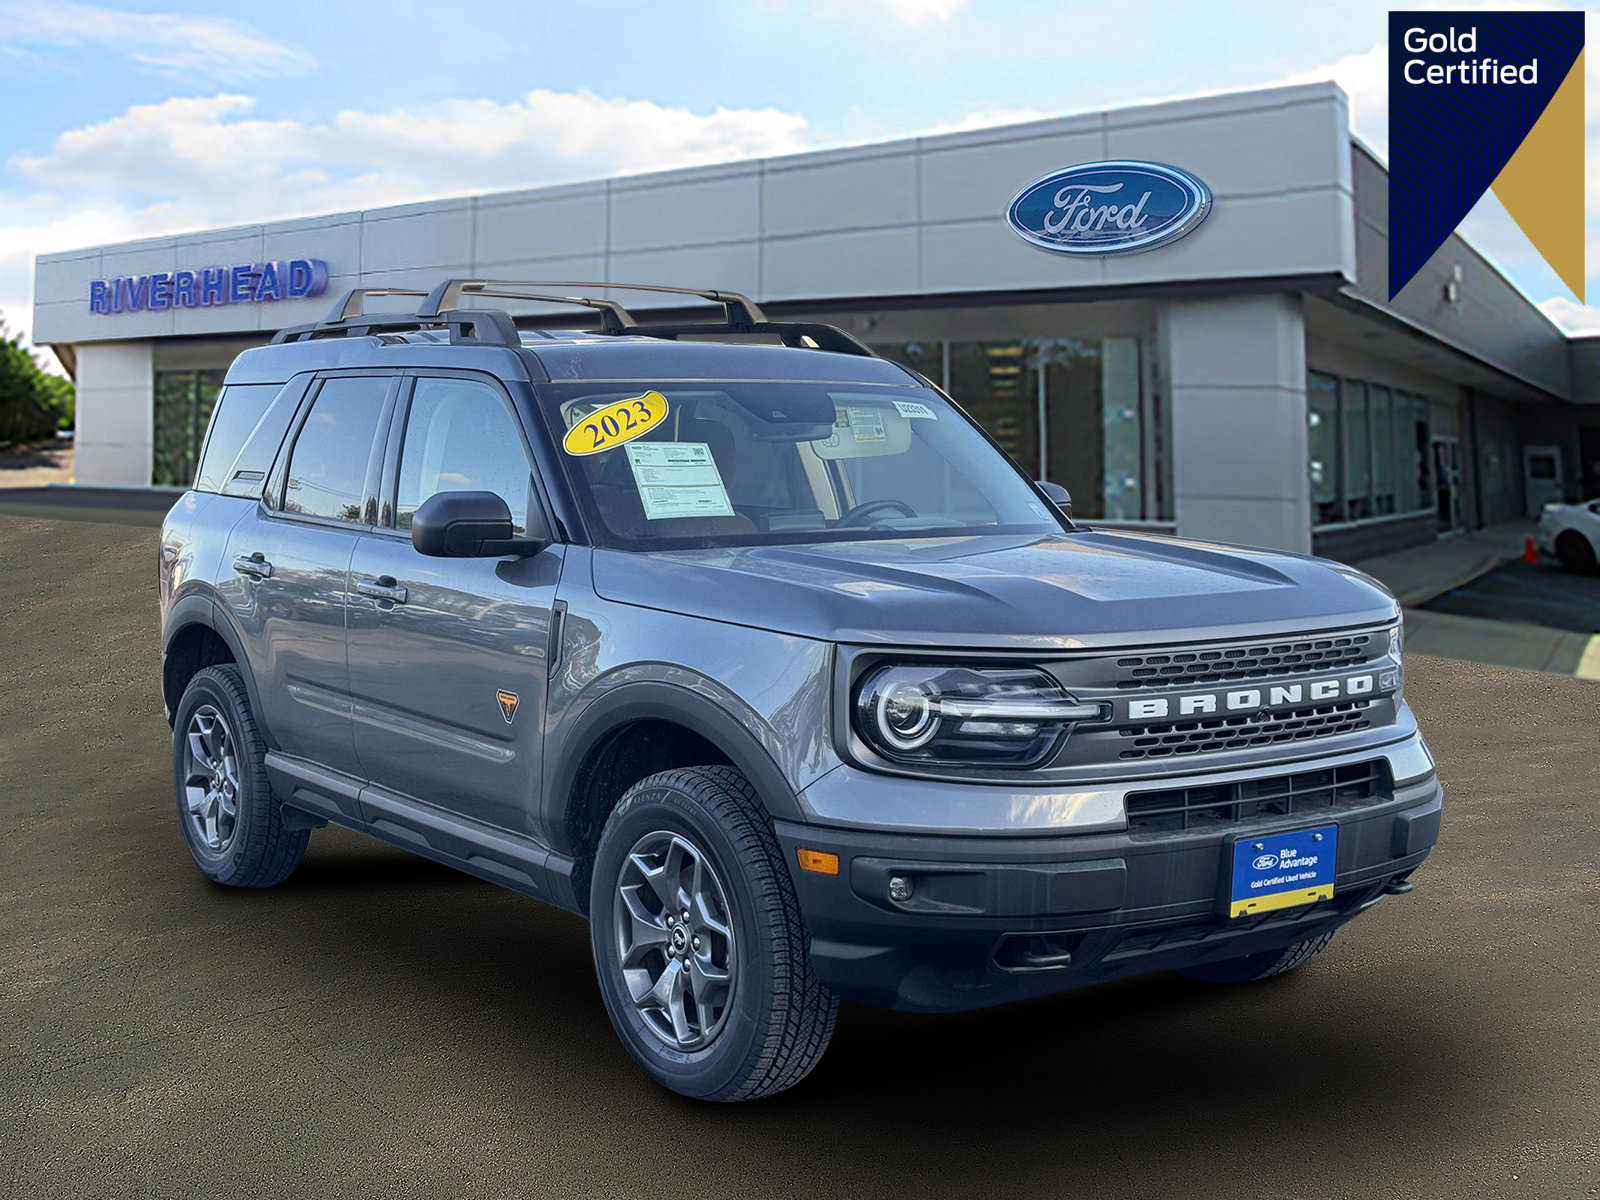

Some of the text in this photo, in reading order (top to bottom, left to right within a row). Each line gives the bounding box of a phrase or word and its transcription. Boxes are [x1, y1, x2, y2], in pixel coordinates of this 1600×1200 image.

[1043, 183, 1152, 234] Ford
[89, 259, 327, 315] RIVERHEAD
[584, 401, 652, 448] 2023
[1129, 675, 1373, 719] BRONCO
[1279, 856, 1318, 870] Advantage
[1280, 848, 1297, 859] Blue
[1250, 871, 1317, 889] Gold Certified Used Vehicle
